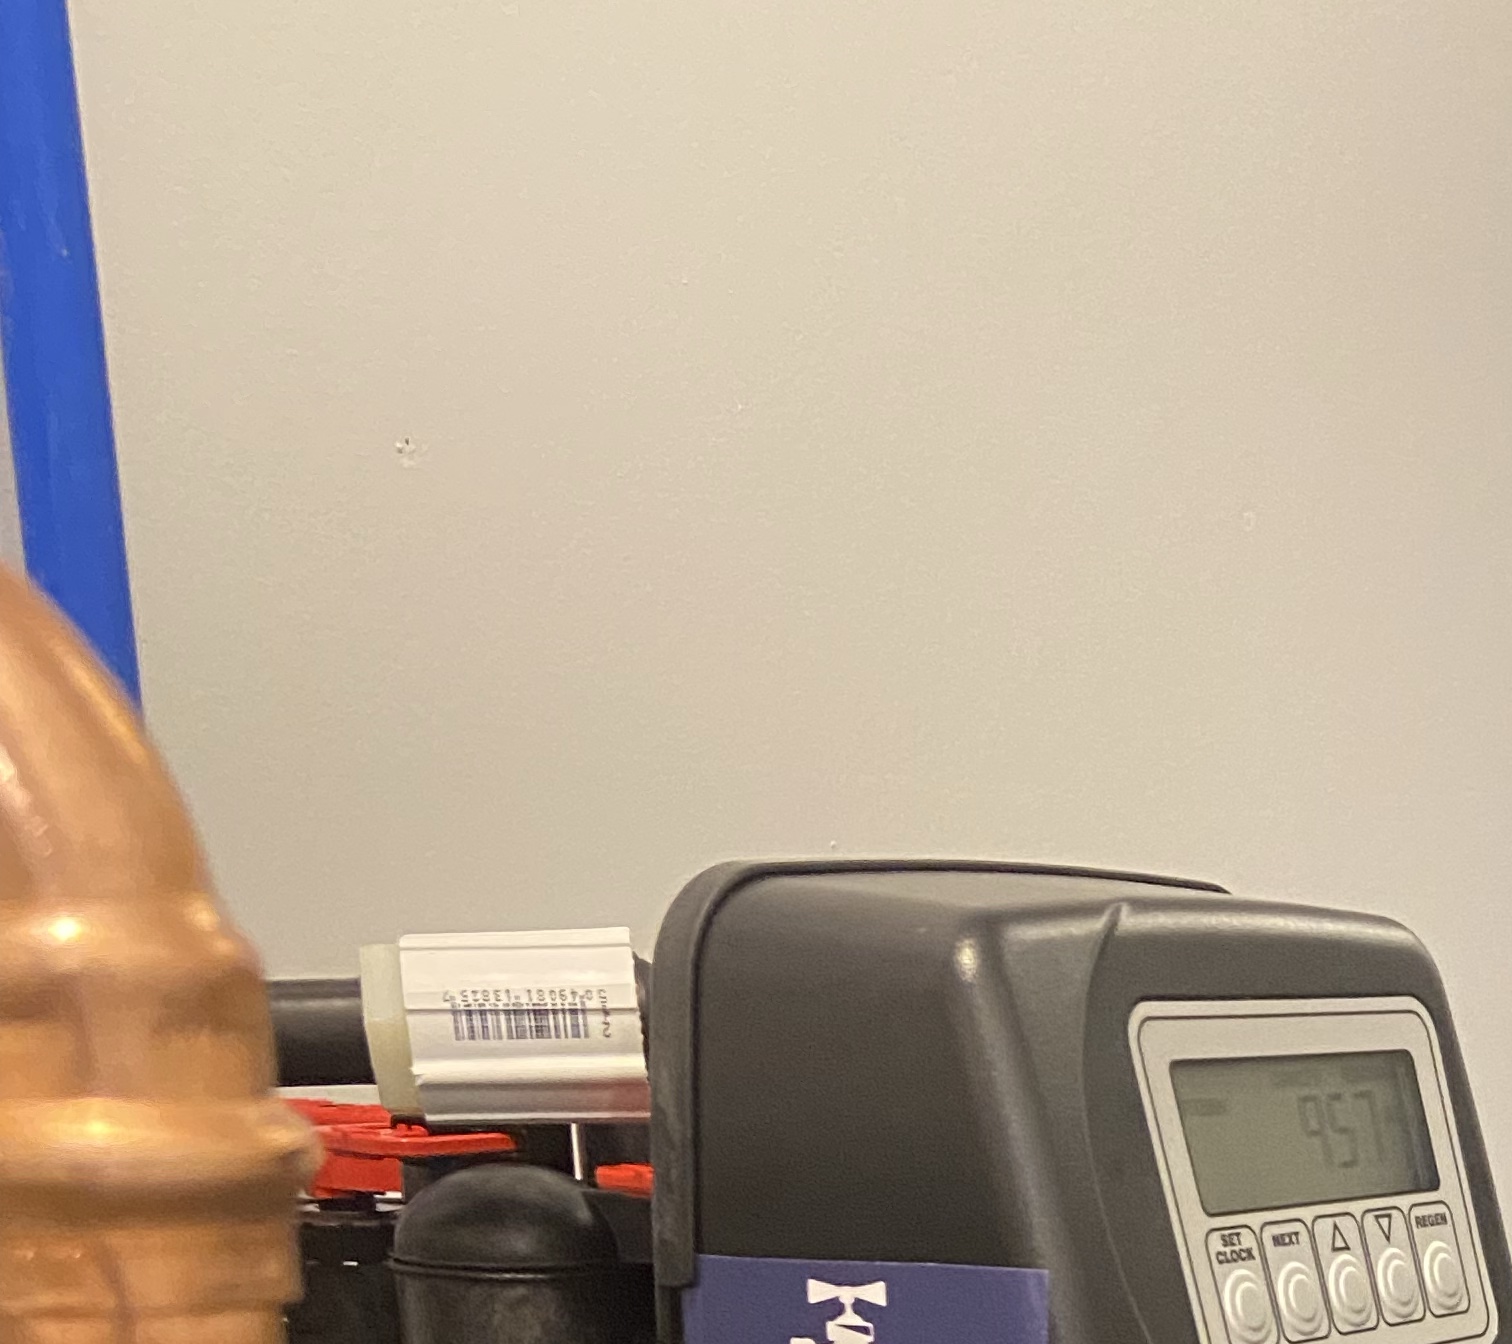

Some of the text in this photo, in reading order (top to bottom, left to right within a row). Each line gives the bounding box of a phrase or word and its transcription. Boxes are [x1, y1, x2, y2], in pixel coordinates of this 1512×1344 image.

[1414, 1212, 1449, 1229] REGEN
[1220, 1231, 1243, 1247] SET
[1272, 1231, 1301, 1247] NEXT
[1216, 1246, 1256, 1265] CLOCK
